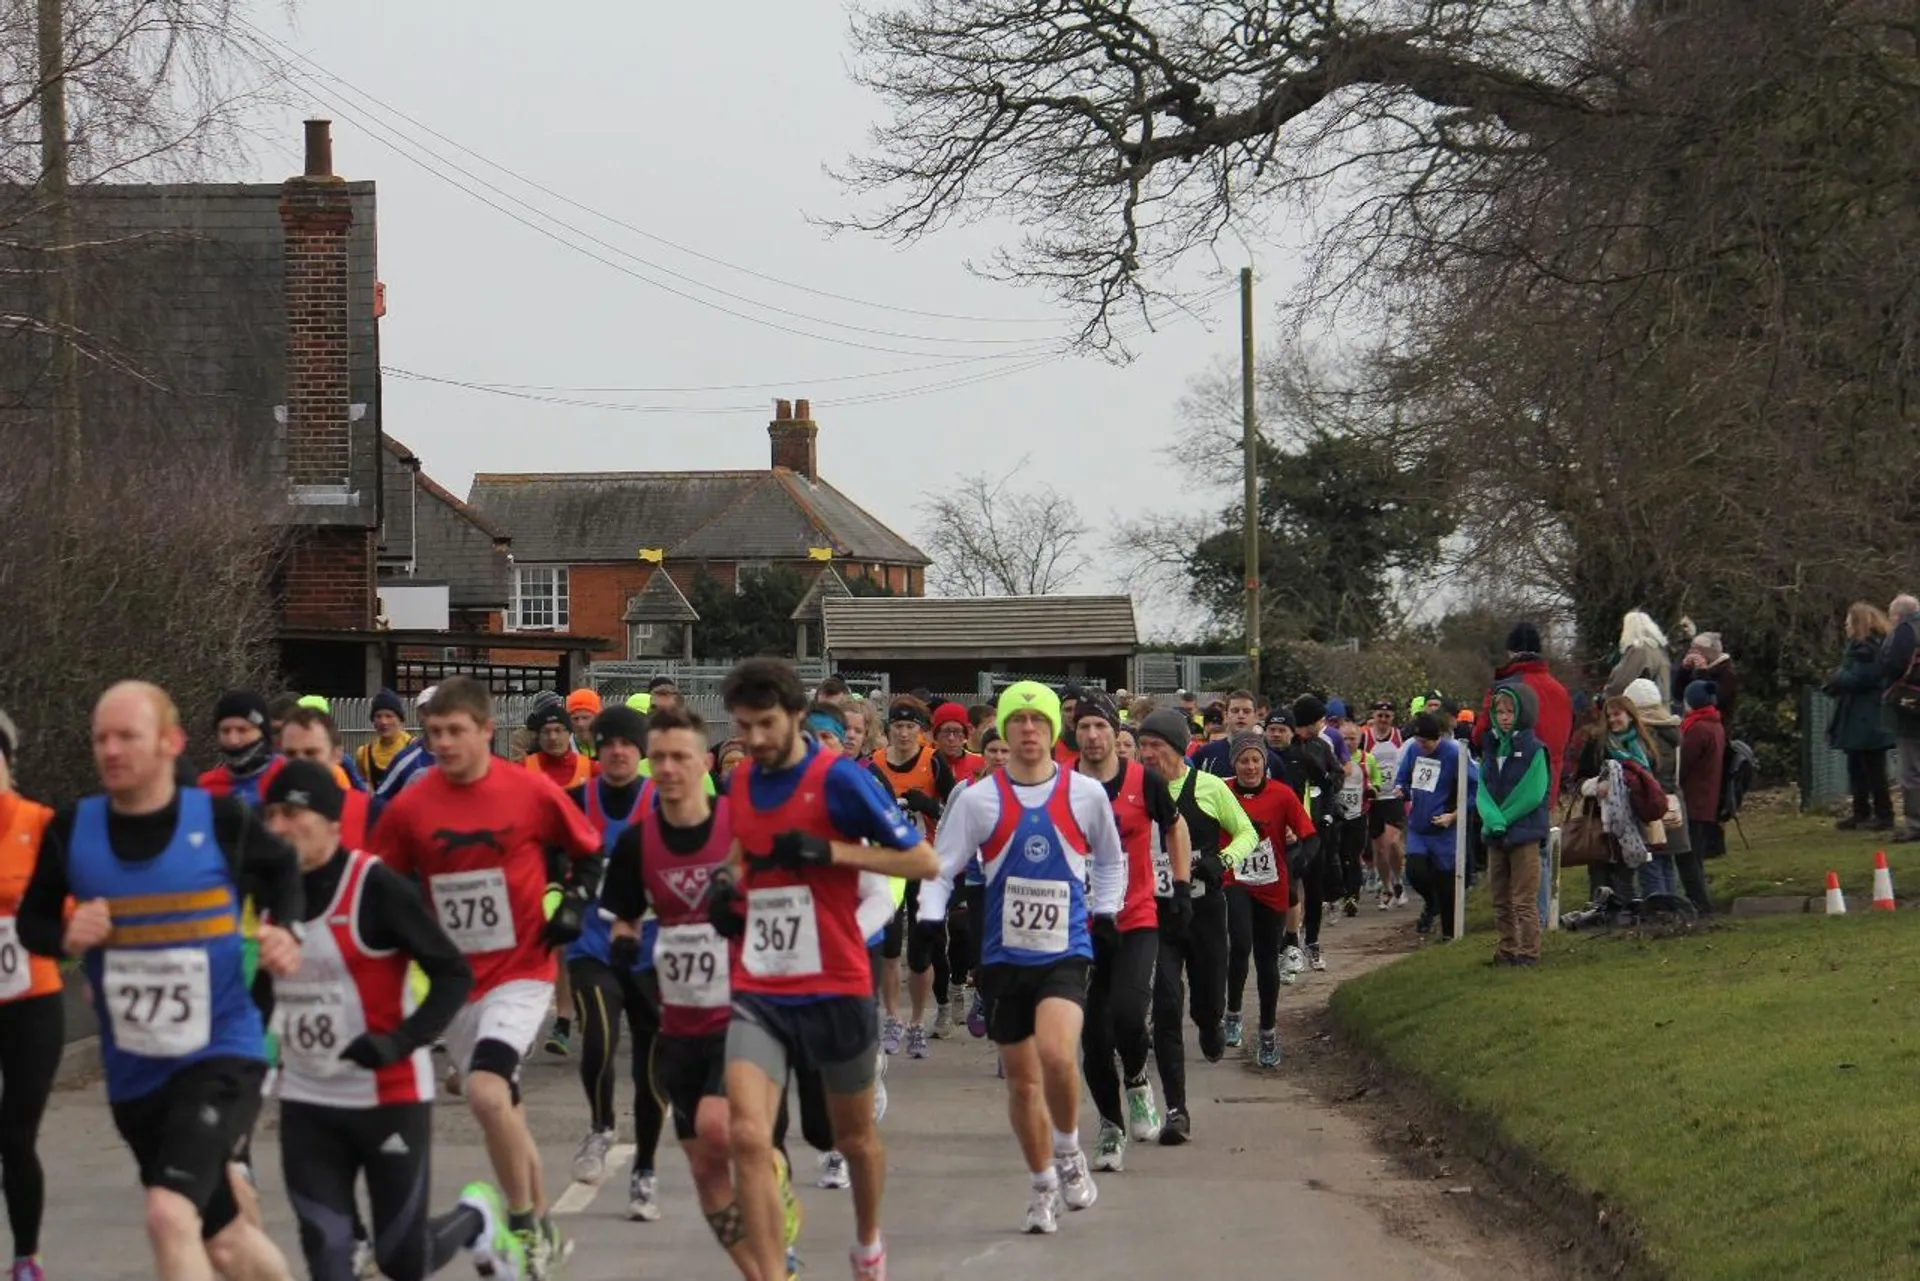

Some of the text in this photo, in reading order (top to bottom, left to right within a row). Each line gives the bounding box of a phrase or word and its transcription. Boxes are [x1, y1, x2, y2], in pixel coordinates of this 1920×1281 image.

[1420, 768, 1432, 781] 29
[444, 896, 498, 930] 378
[1010, 900, 1060, 930] 329
[754, 916, 801, 951] 367
[663, 952, 715, 983] 379
[119, 985, 191, 1023] 275
